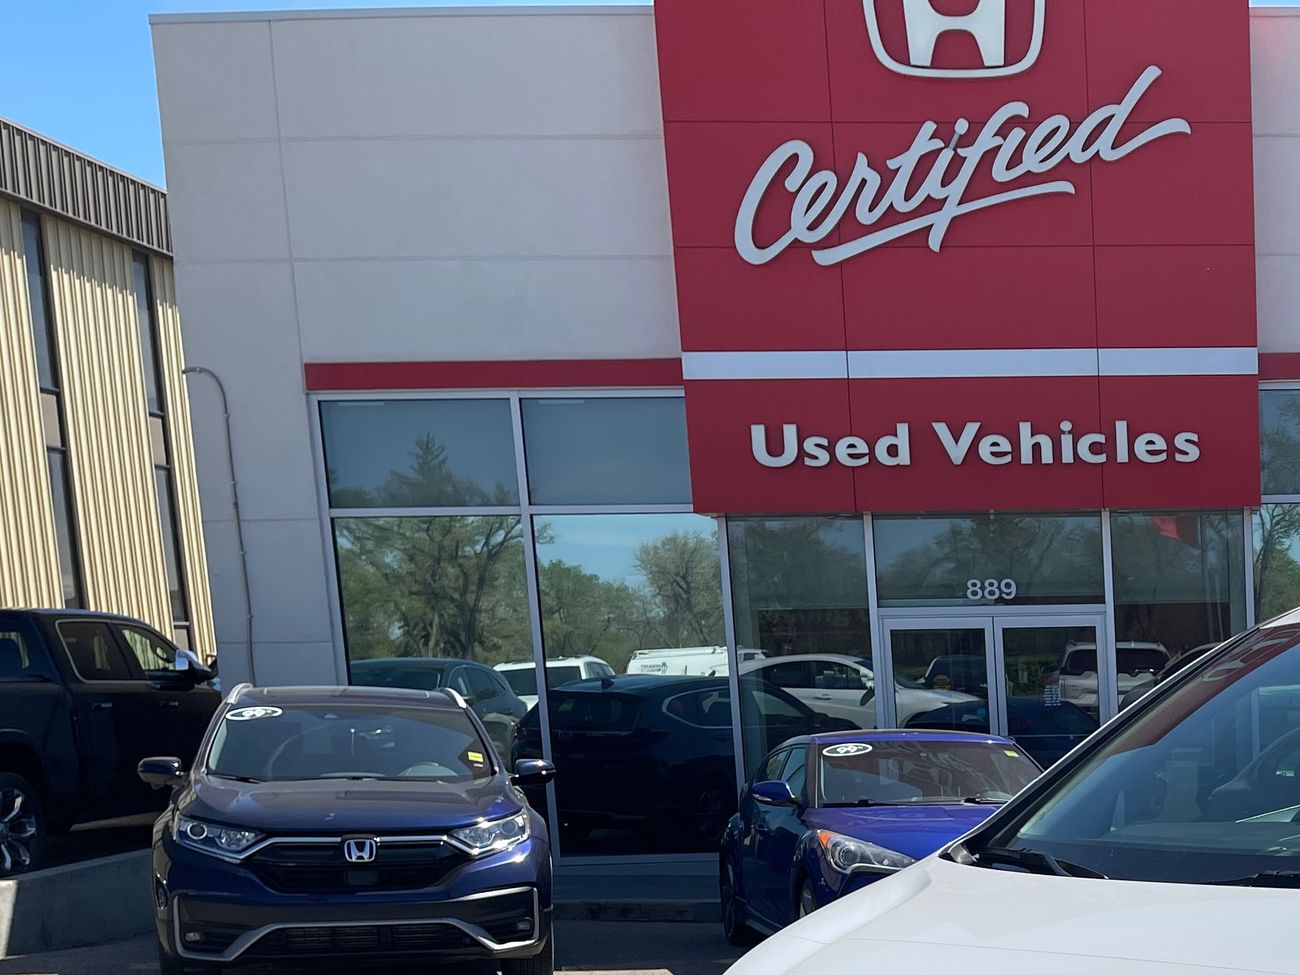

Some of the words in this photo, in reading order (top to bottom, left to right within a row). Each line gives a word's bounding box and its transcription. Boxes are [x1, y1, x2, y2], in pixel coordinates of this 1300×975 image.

[734, 65, 1192, 266] Certified
[750, 422, 911, 468] Used
[931, 420, 1200, 465] Vehicles
[966, 578, 1017, 601] 889
